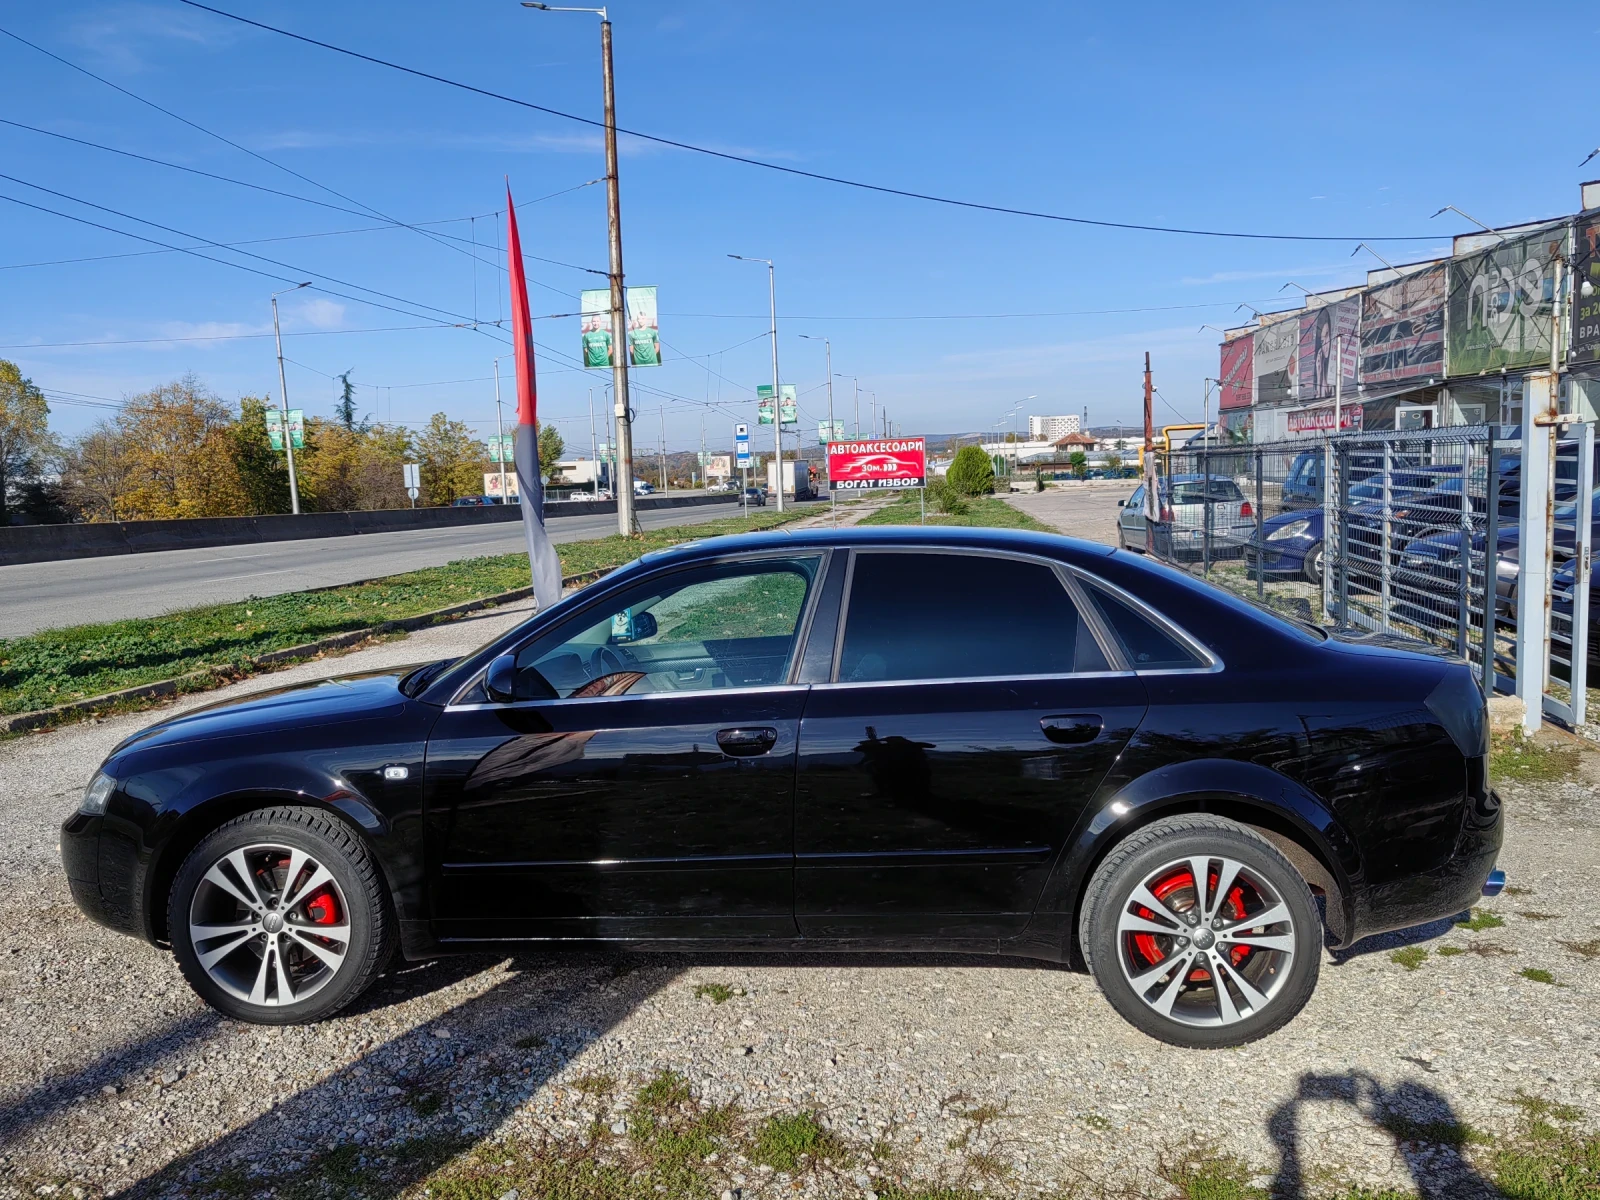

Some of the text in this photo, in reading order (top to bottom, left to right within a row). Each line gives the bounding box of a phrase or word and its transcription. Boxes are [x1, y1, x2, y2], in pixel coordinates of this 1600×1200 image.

[1289, 409, 1351, 429] АВТОАКСЕСОРИ
[830, 441, 923, 455] АВТОАКСЕСОАРИ
[861, 464, 882, 472] 30м.
[836, 477, 919, 489] БОГАТ ИЗБОР
